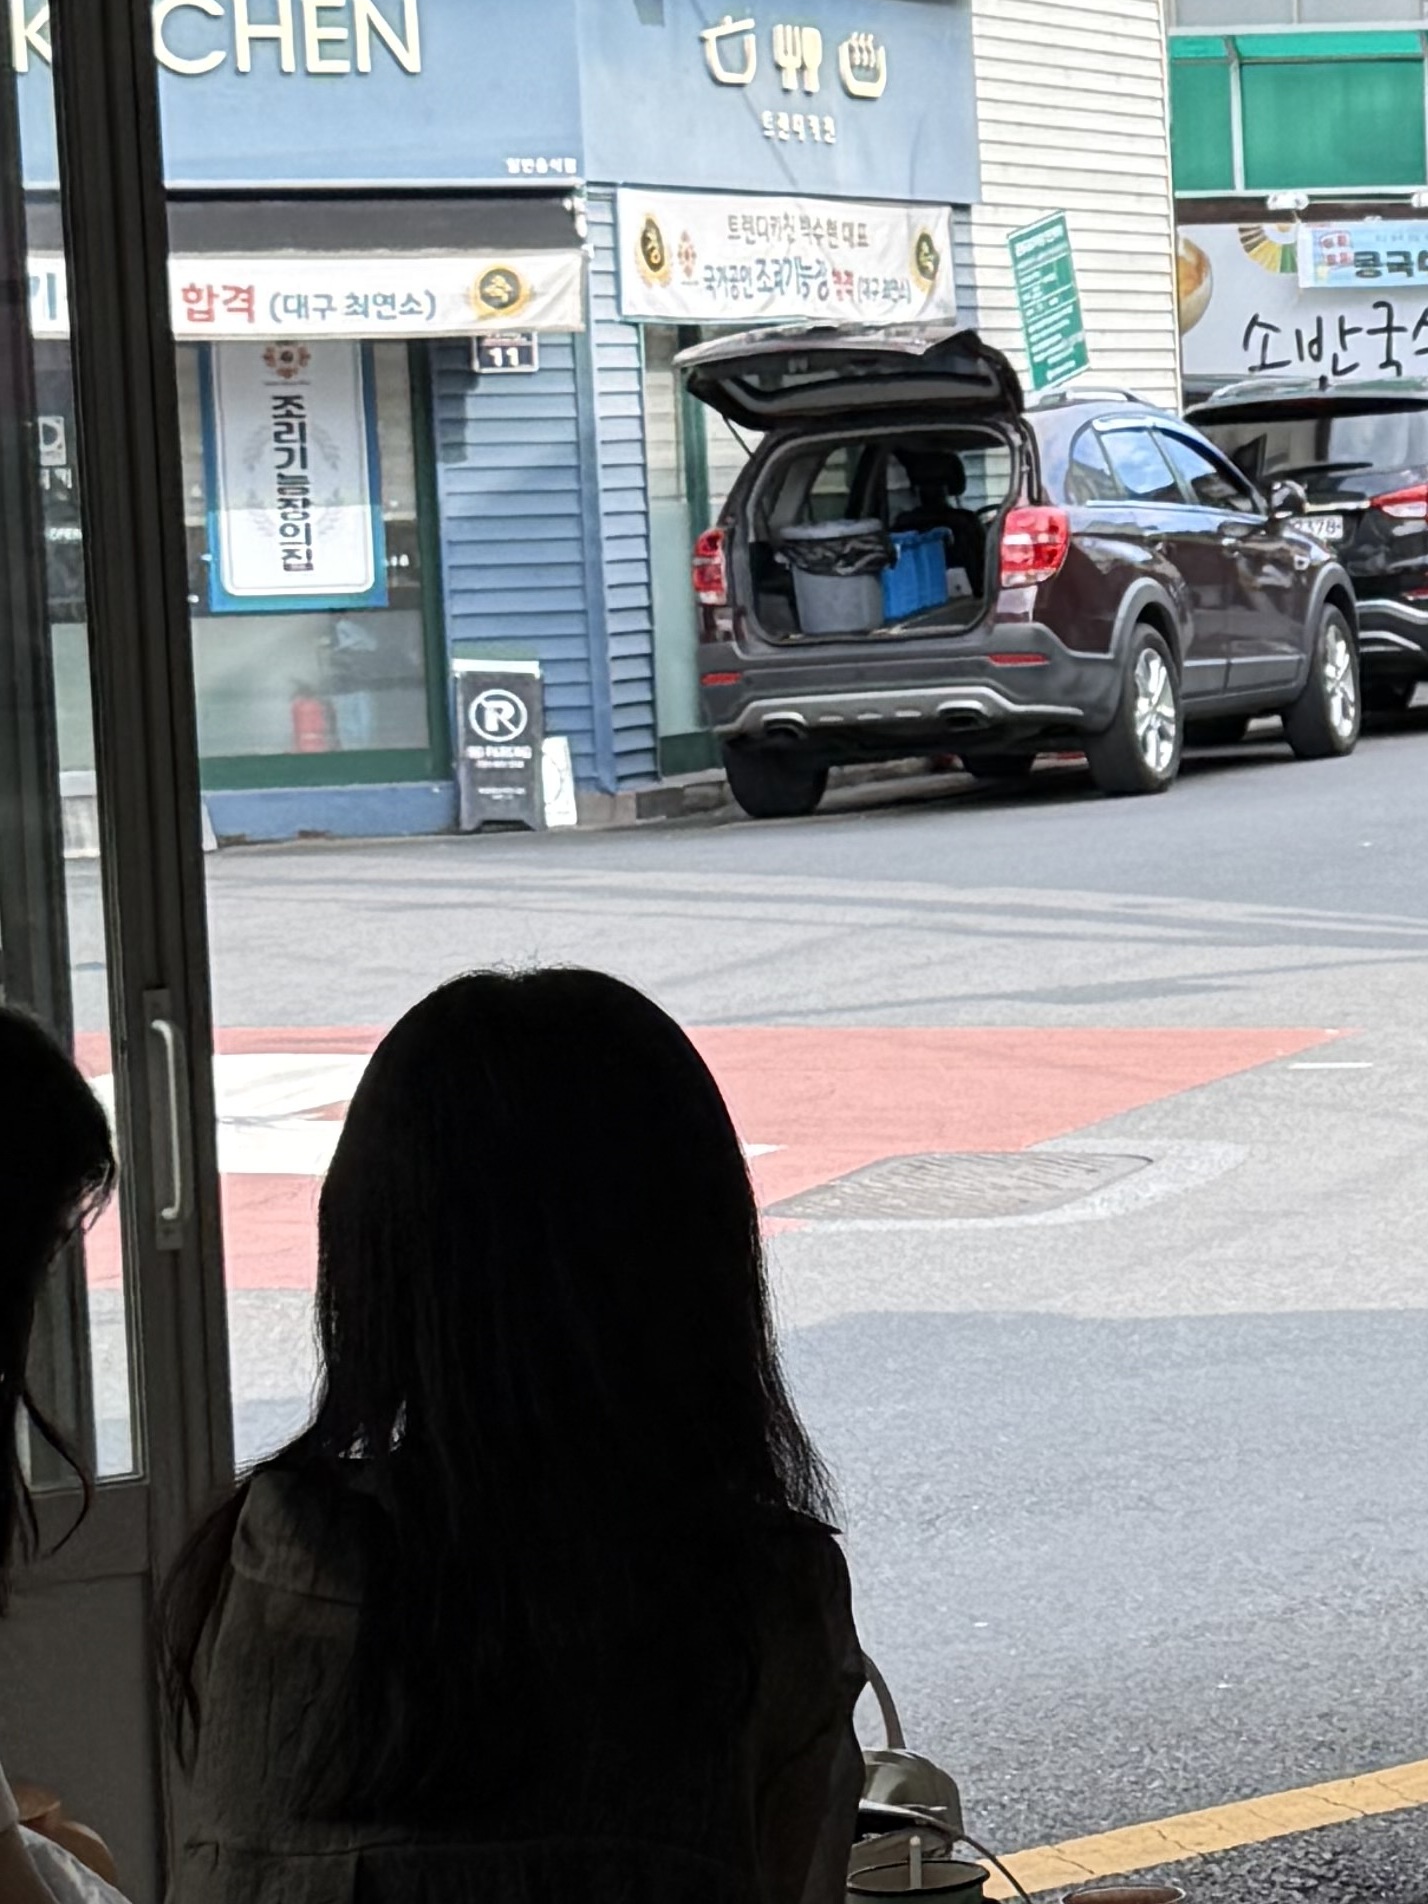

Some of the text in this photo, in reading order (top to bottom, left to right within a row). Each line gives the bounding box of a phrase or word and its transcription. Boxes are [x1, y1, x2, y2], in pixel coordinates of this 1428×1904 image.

[181, 283, 437, 324] 합격 (대구 최연소)
[271, 395, 314, 572] 조리기능장의집
